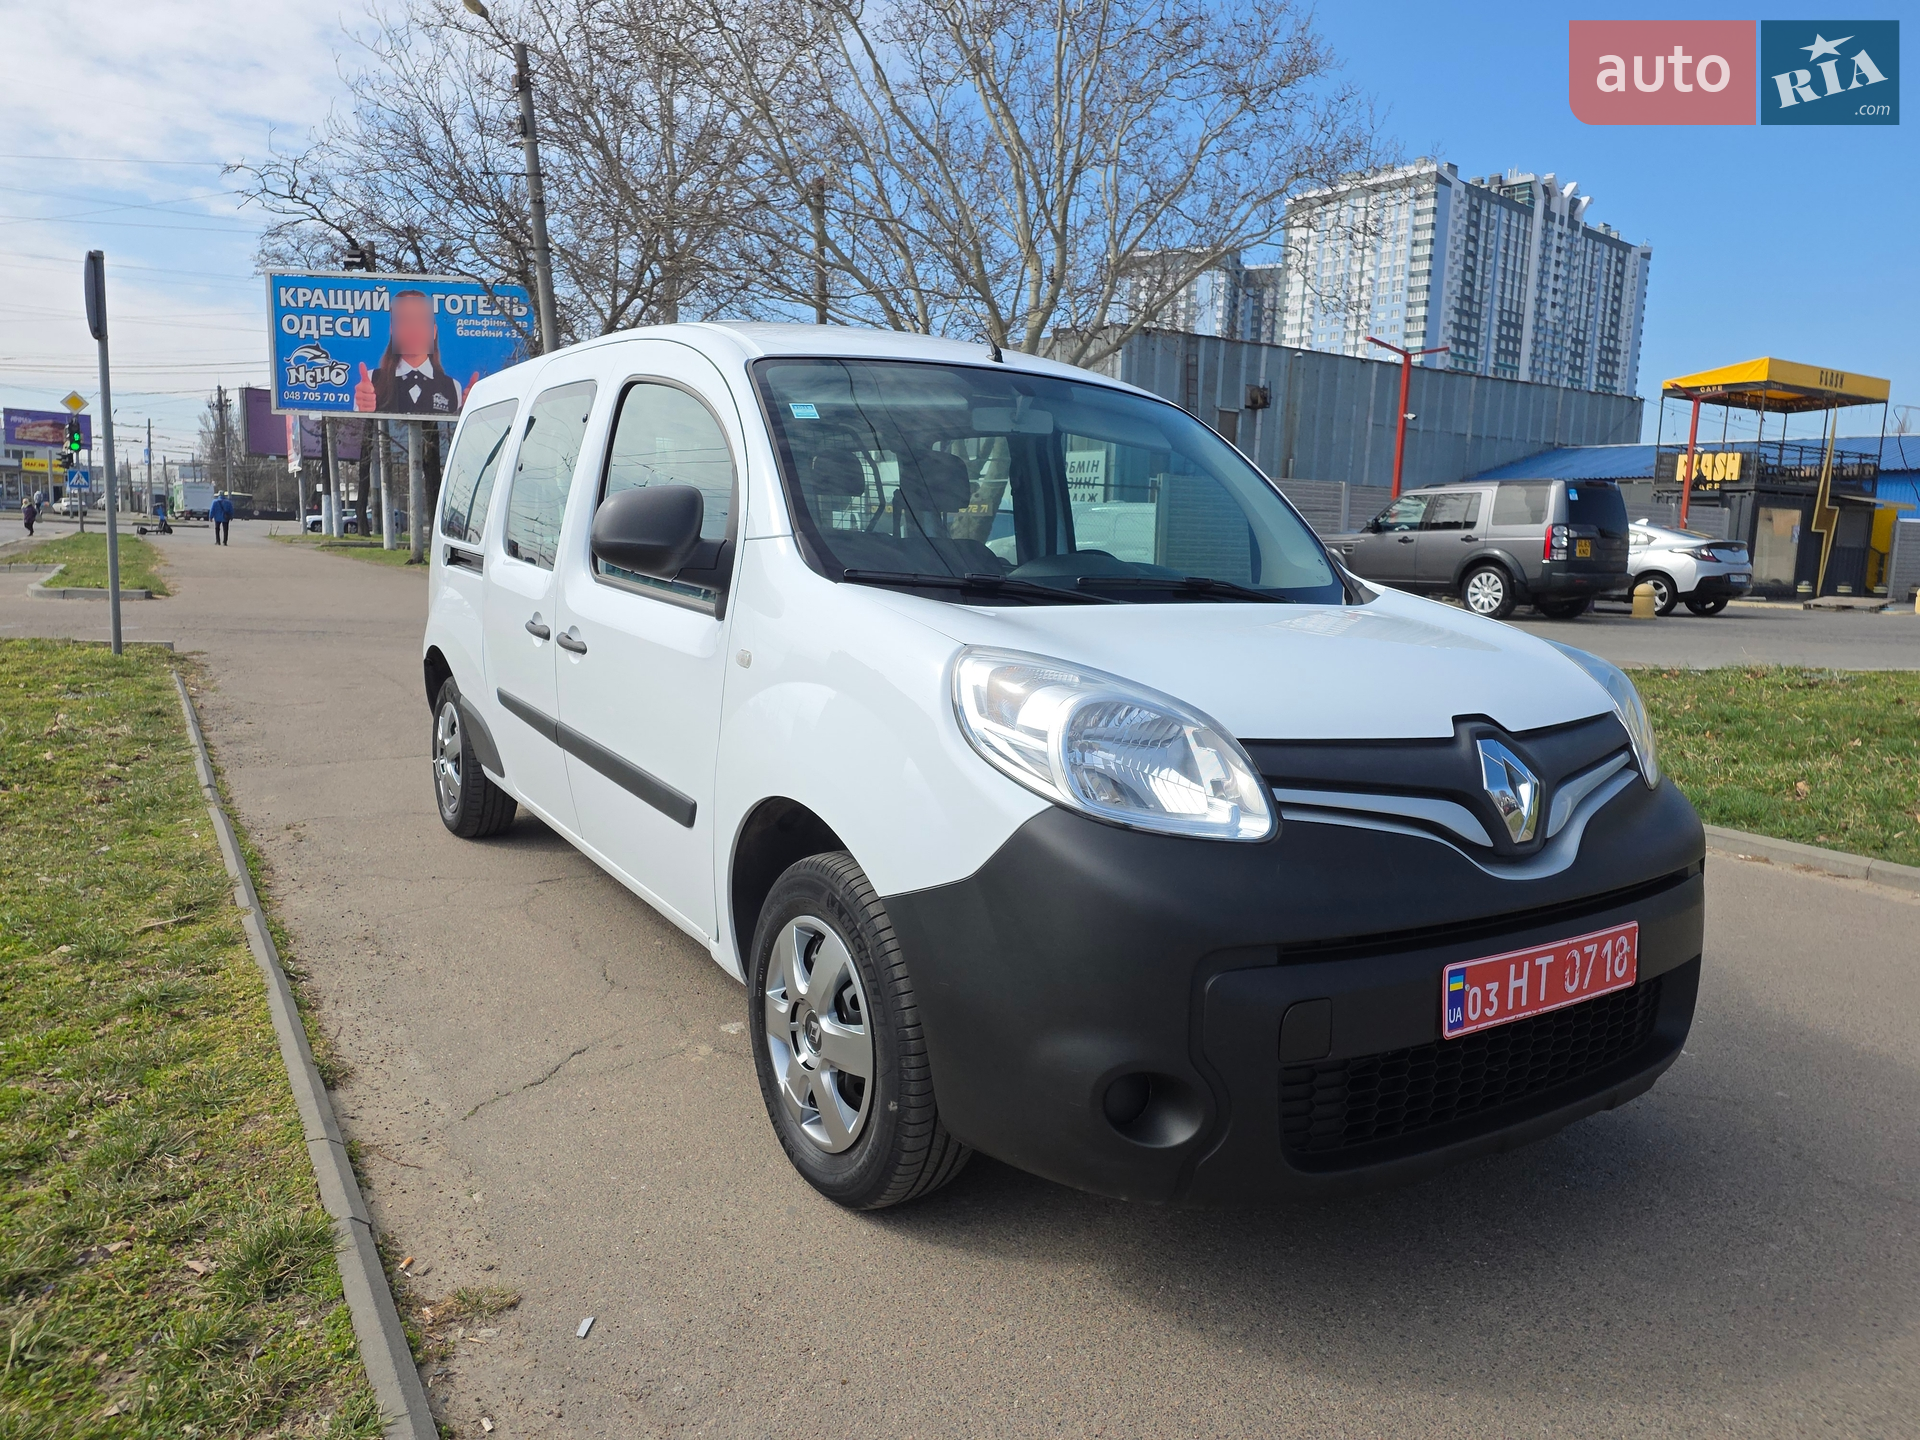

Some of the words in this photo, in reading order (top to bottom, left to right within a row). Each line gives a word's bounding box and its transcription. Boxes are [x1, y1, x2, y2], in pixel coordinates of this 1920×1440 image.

[279, 285, 390, 314] КРАЩИЙ
[432, 293, 528, 317] ГОТЕЛЬ
[281, 314, 370, 339] ОДЕСИ
[456, 327, 503, 338] басейни
[1819, 370, 1845, 389] FLASH
[283, 391, 301, 400] 048
[302, 391, 321, 401] 705
[323, 392, 335, 402] 70
[337, 393, 350, 403] 70
[1700, 385, 1723, 393] CAFE
[1067, 476, 1100, 490] ЗИНГ
[1448, 1008, 1463, 1024] UA
[1467, 981, 1499, 1021] 03
[1507, 955, 1554, 1010] HT
[1564, 935, 1629, 994] 0718
